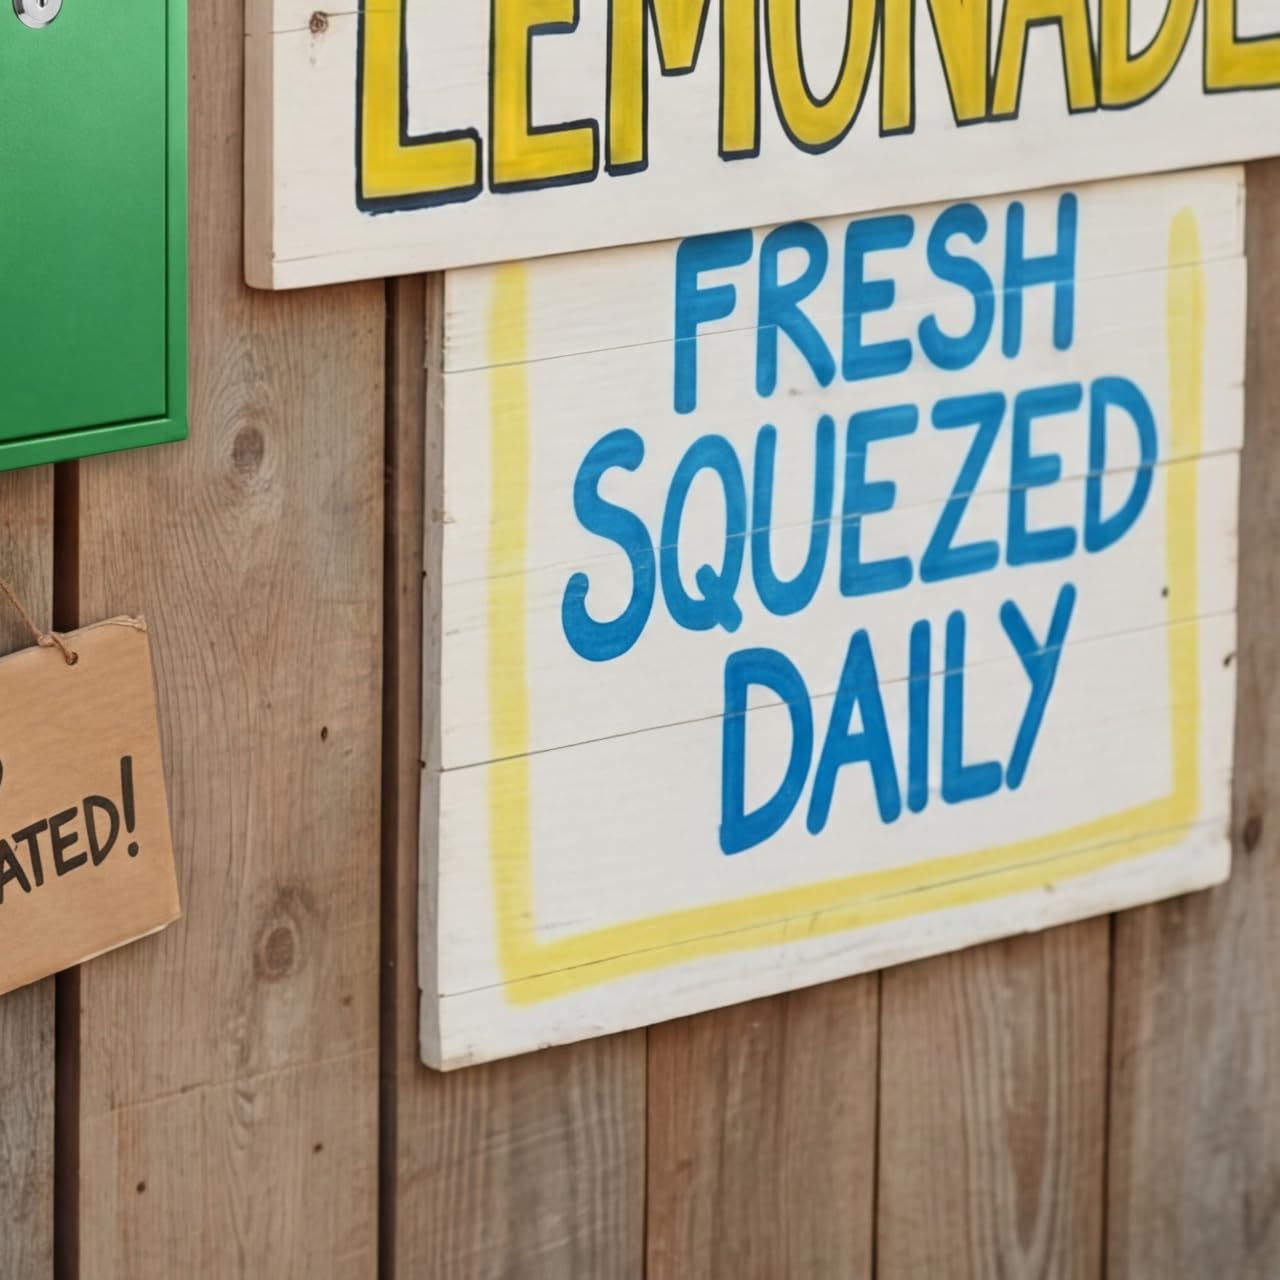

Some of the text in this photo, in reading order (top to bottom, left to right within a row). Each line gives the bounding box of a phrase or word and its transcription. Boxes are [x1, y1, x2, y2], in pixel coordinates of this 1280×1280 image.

[673, 192, 1078, 414] FRESH
[561, 376, 1158, 662] SQUEZED
[719, 582, 1077, 855] DAILY
